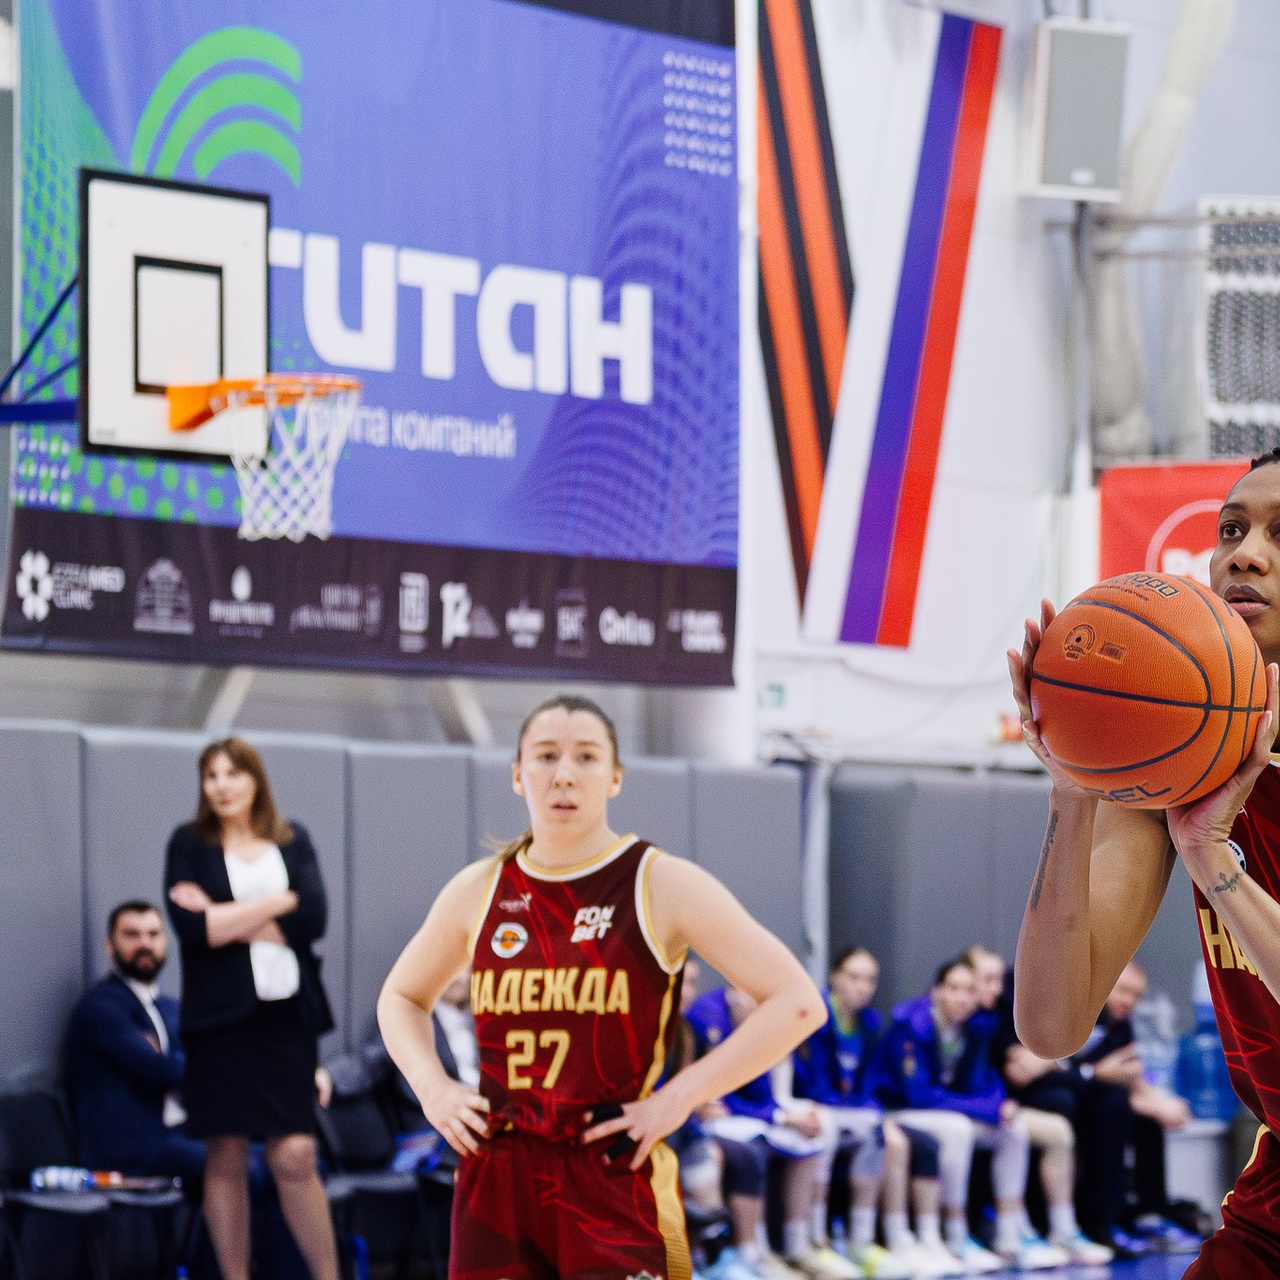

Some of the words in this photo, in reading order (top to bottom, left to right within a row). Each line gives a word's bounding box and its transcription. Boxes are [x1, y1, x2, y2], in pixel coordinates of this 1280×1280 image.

[391, 409, 517, 460] компаний
[570, 921, 612, 943] BET
[573, 905, 616, 926] FON
[505, 1029, 571, 1090] 27
